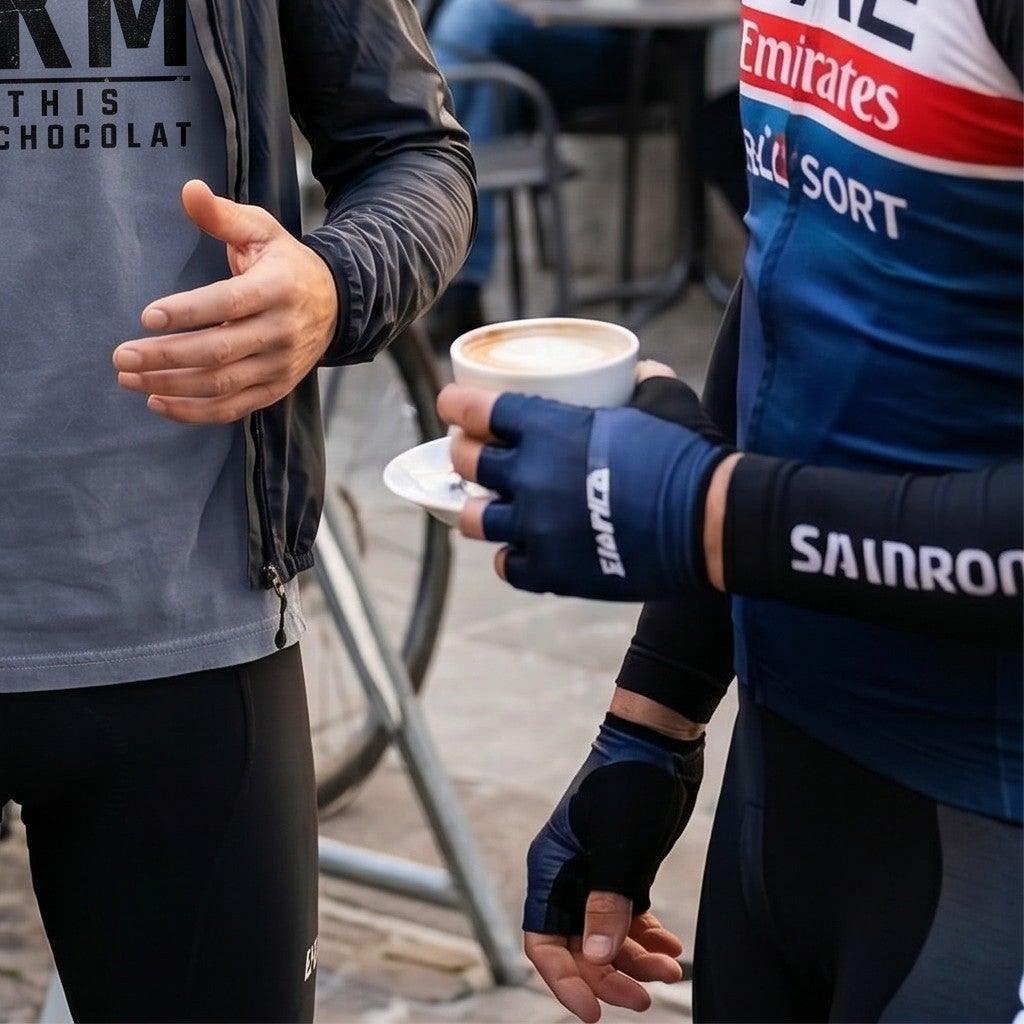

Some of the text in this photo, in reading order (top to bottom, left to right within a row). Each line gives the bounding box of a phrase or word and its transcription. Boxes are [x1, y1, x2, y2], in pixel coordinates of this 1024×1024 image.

[7, 88, 118, 118] THIS
[739, 18, 901, 132] Emirates
[800, 154, 908, 240] SORT
